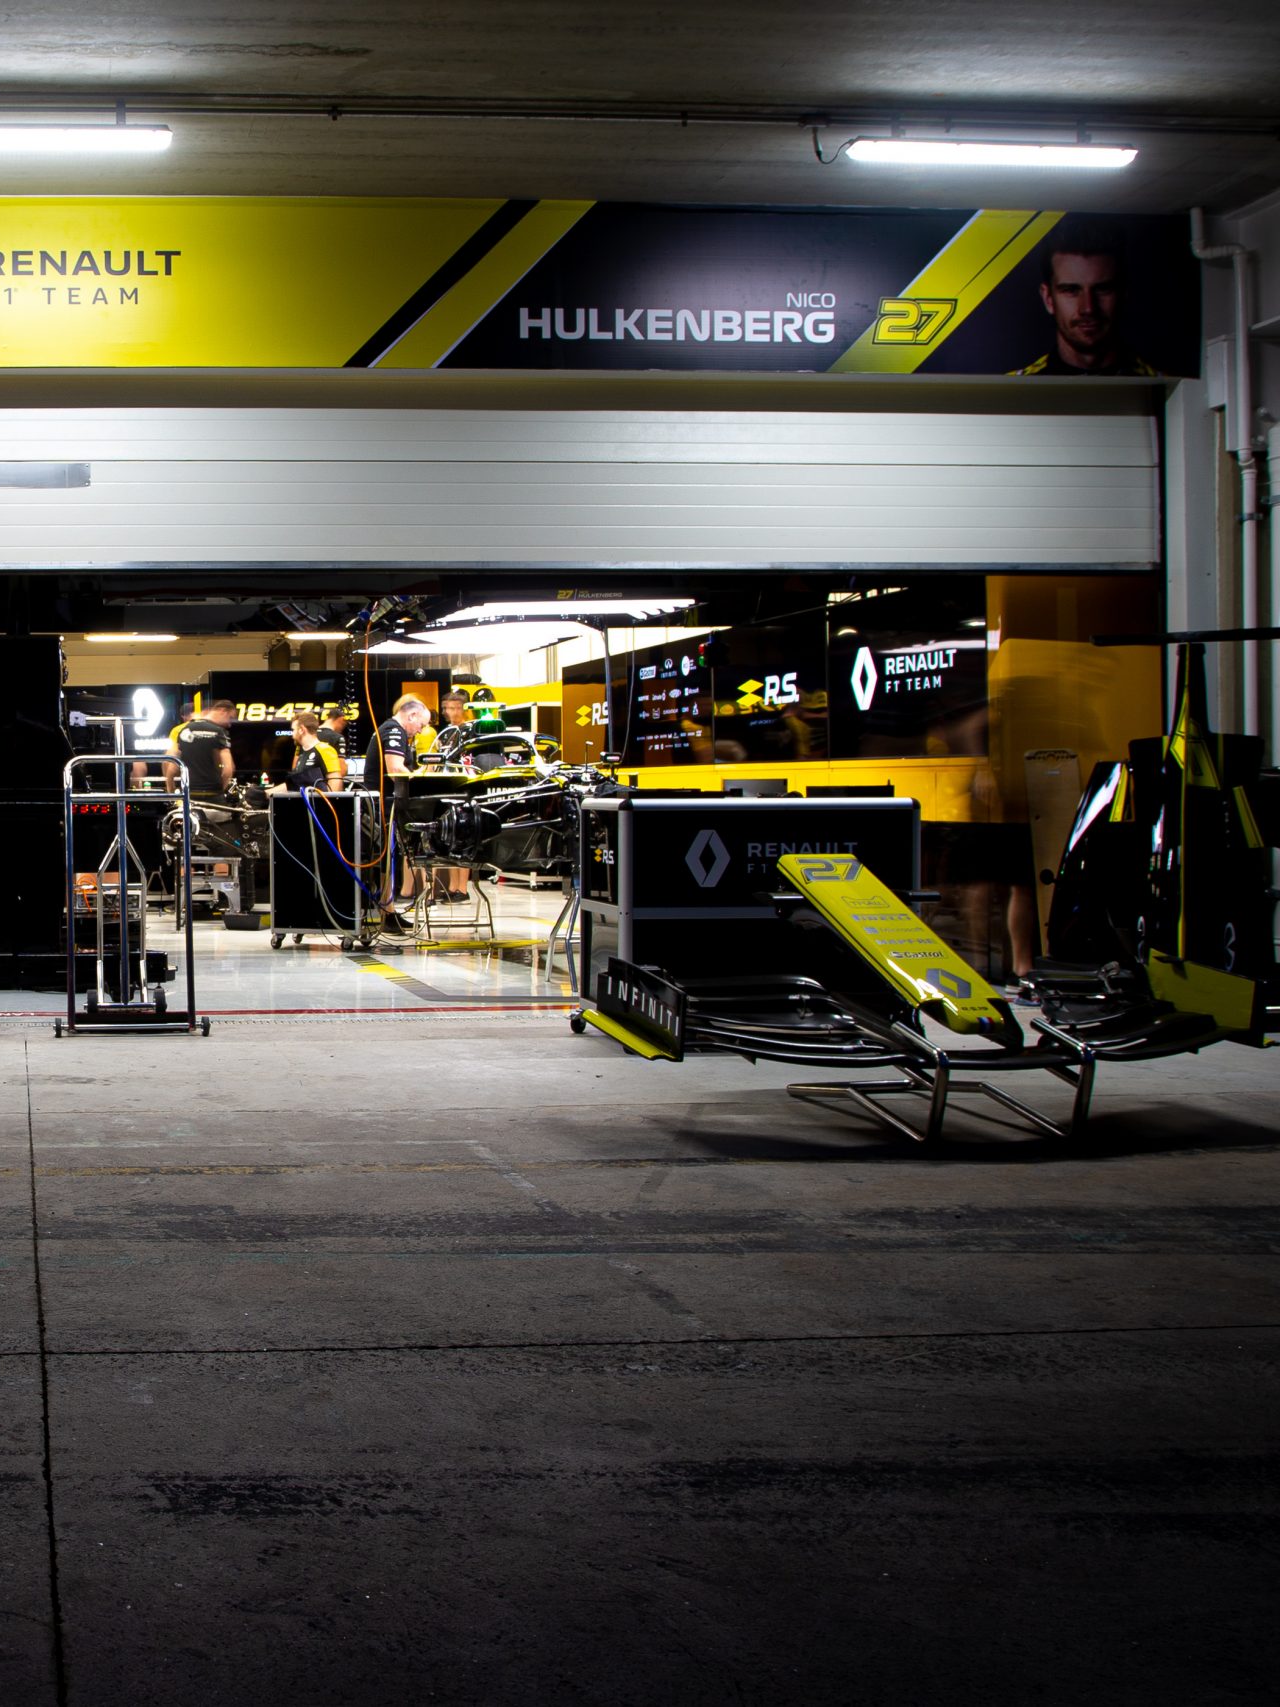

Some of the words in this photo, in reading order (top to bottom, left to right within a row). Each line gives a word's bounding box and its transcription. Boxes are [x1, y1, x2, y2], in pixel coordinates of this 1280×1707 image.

[42, 288, 139, 305] TEAM
[786, 292, 836, 308] NICO
[519, 307, 835, 343] HULKENBERG
[872, 297, 957, 345] 27
[556, 589, 574, 600] 27
[885, 648, 957, 675] RENAULT
[885, 680, 900, 693] F1
[905, 674, 942, 691] TEAM
[747, 863, 766, 874] F1
[795, 857, 863, 884] 27
[851, 913, 911, 922] PIRELLI
[904, 951, 944, 959] Castrol
[607, 976, 680, 1037] INFINITI
